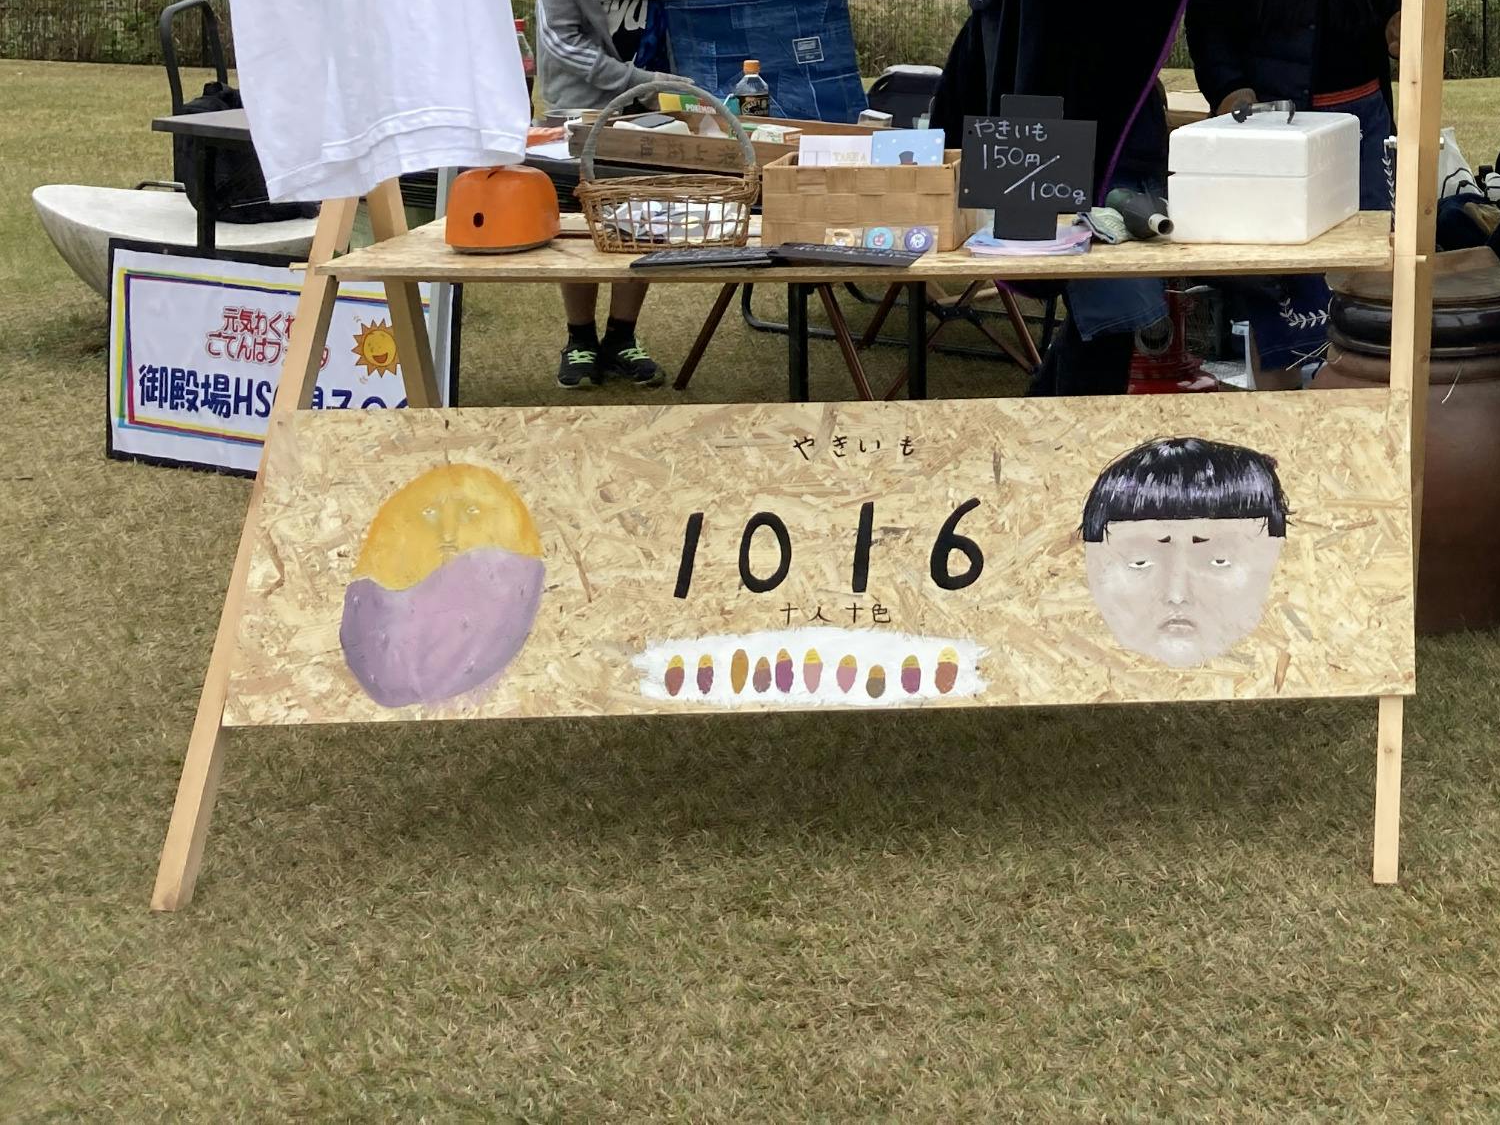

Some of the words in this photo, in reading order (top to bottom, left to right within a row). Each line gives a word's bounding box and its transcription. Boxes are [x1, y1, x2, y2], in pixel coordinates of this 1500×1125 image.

[974, 119, 1048, 141] やきいも
[983, 144, 1040, 170] 150円
[1030, 181, 1086, 205] 100g
[792, 435, 916, 461] やきいも
[673, 497, 985, 599] 1016
[779, 602, 892, 625] 十人十色
